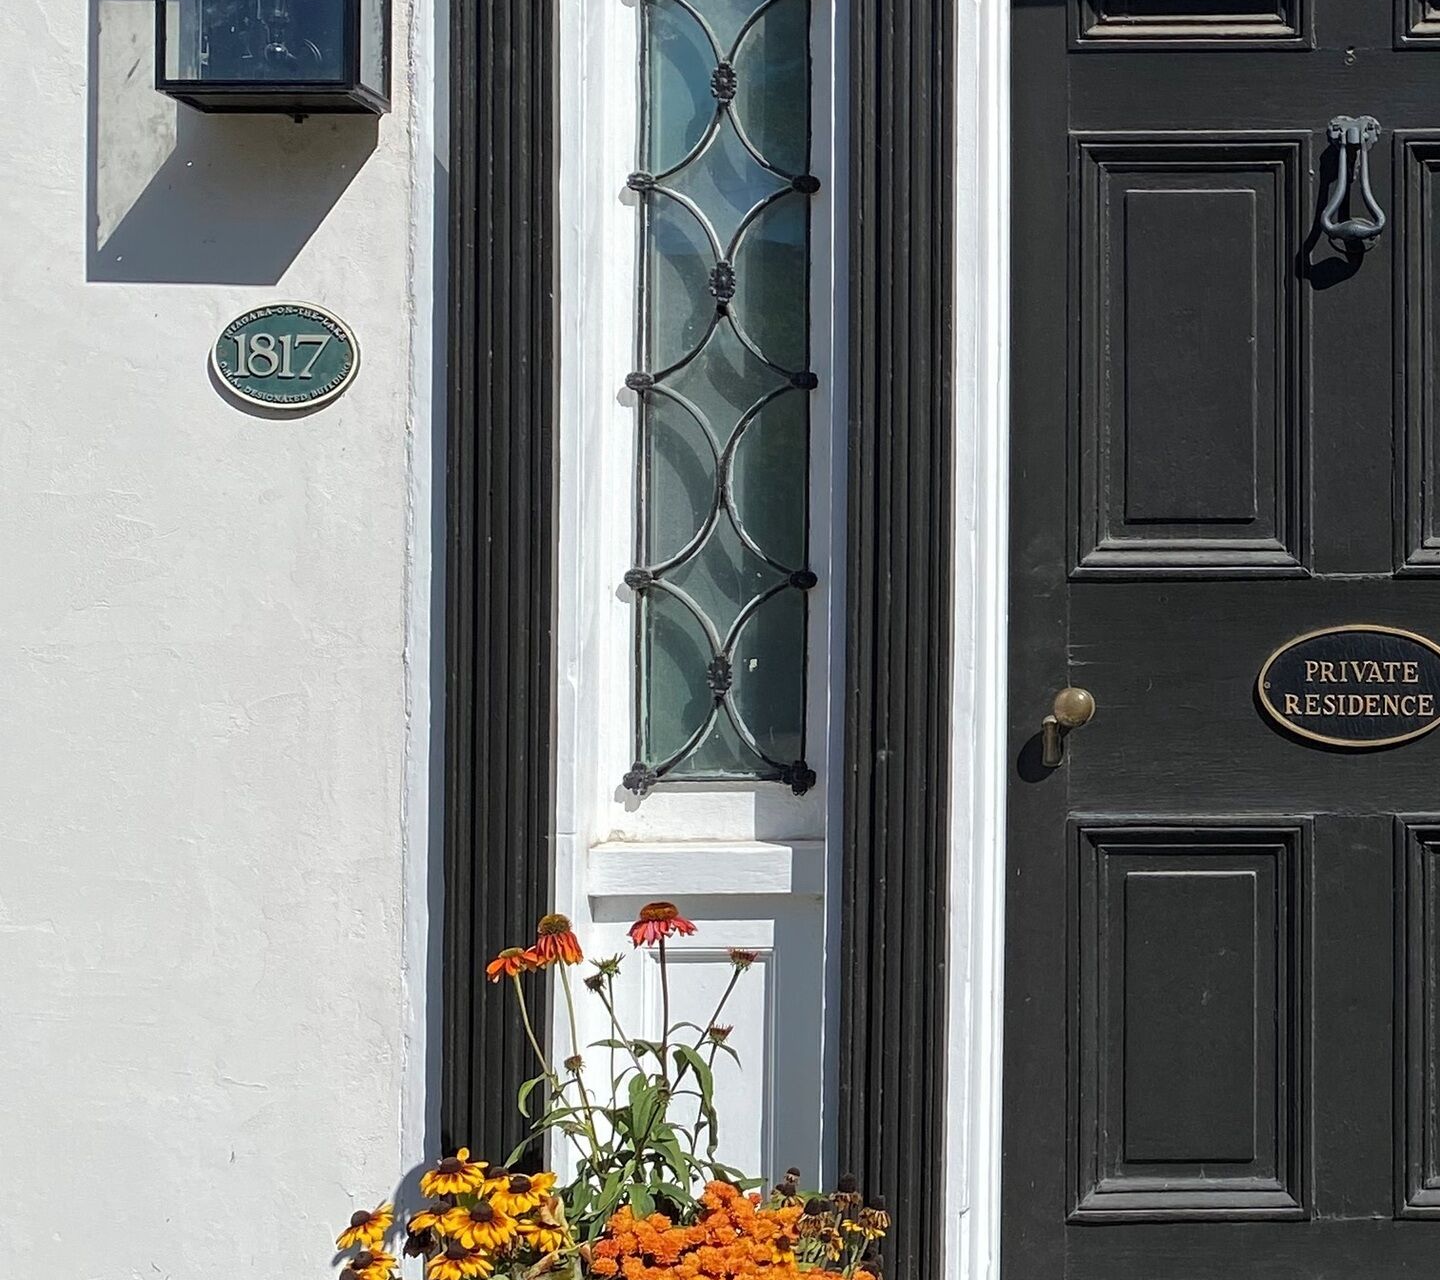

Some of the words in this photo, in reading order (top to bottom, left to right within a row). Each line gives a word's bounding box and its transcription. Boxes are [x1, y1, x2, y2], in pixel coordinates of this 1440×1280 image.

[224, 306, 348, 342] NIAGARA-ON-THE-LAKE
[233, 332, 333, 379] 1817
[244, 385, 308, 403] DESIGNATED
[310, 361, 352, 398] BUILDING
[1304, 660, 1419, 683] PRIVATE
[1284, 693, 1434, 717] RESIDENCE
